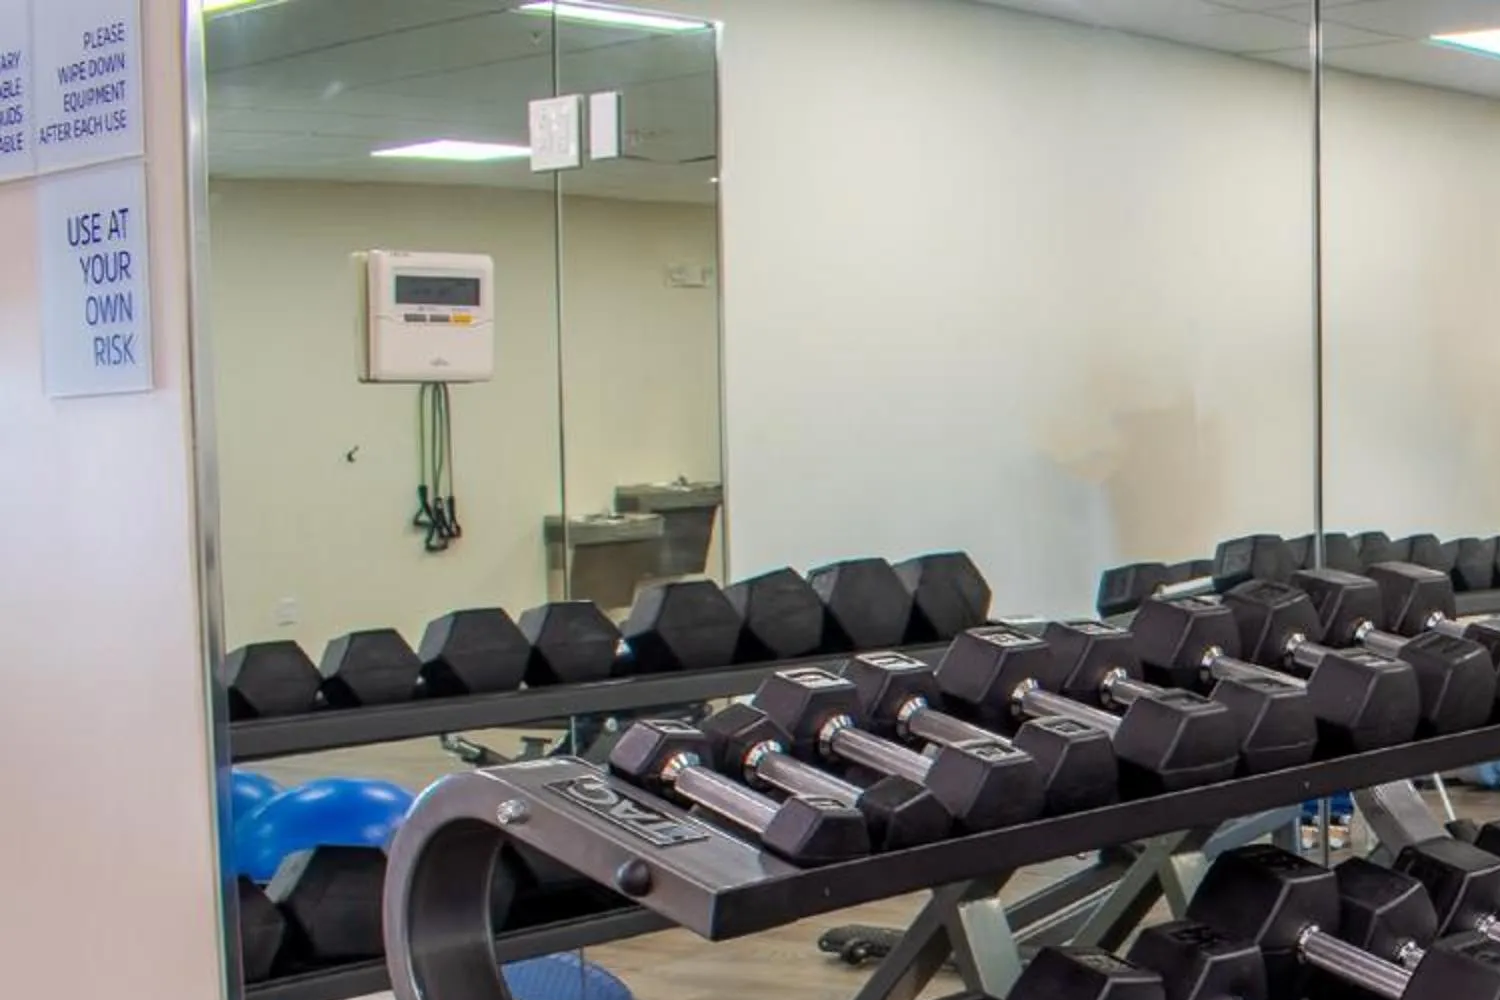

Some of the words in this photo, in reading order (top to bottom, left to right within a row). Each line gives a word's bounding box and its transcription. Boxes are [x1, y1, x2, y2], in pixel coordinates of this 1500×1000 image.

[83, 22, 125, 49] PLEASE
[57, 61, 87, 86] WIPE
[89, 52, 125, 79] DOWN
[63, 80, 125, 113] EQUIPMENT
[39, 121, 71, 144] AFTER
[73, 114, 103, 139] EACH
[105, 109, 127, 132] USE
[67, 212, 102, 247] USE
[107, 207, 129, 241] AT
[79, 250, 132, 284] YOUR
[85, 292, 133, 326] OWN
[94, 332, 136, 366] RISK
